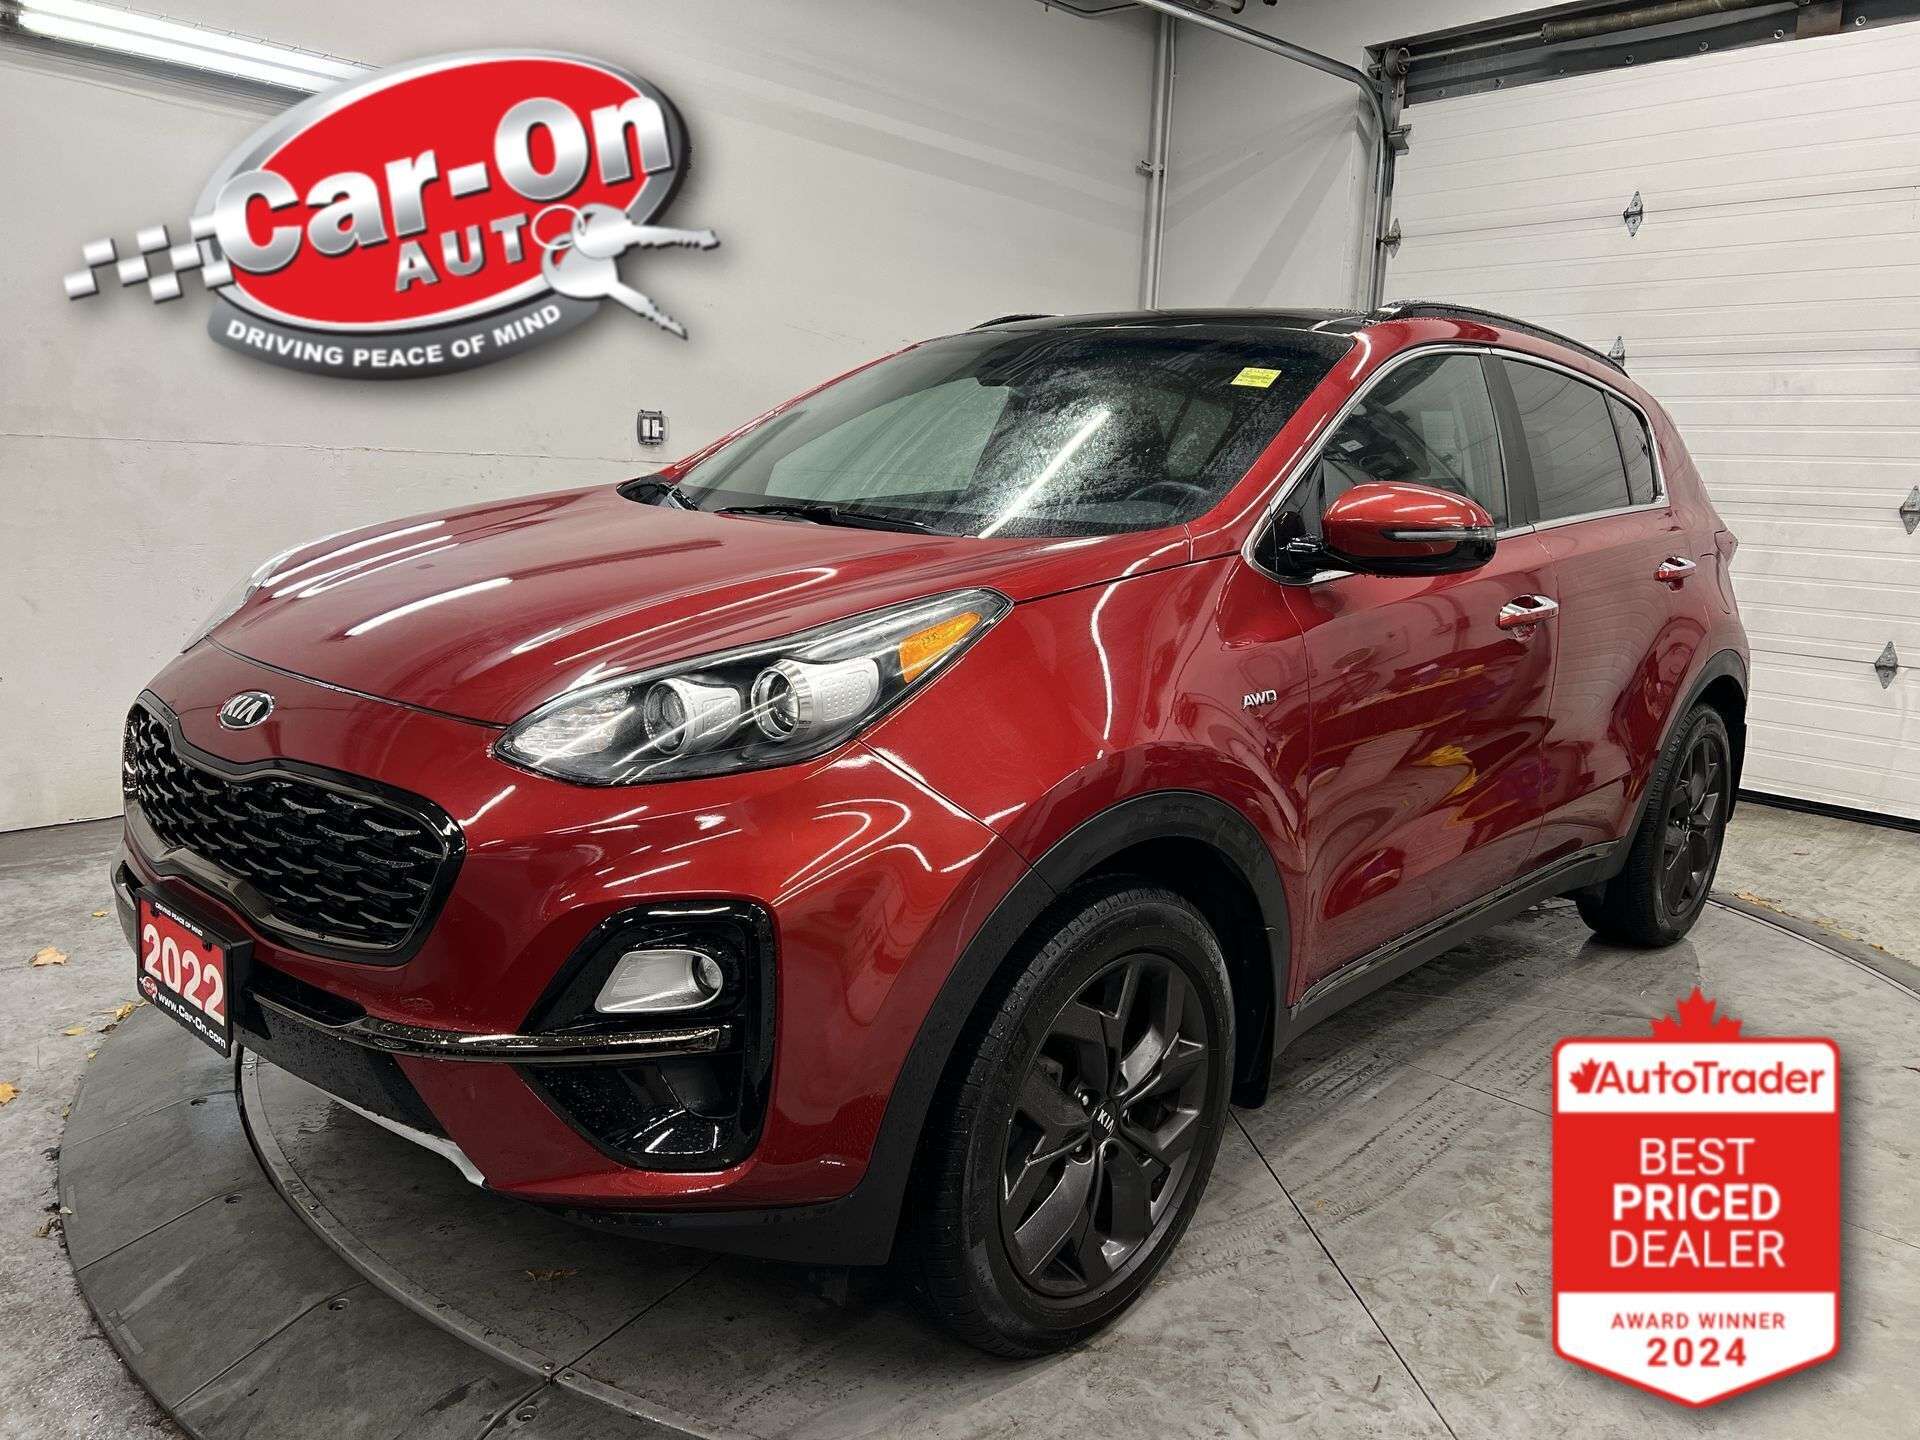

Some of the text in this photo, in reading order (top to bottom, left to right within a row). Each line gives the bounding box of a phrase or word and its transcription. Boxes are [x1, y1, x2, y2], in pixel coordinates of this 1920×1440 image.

[223, 695, 264, 724] KIA
[1243, 689, 1278, 707] AWD
[143, 923, 225, 1027] 2022
[157, 991, 227, 1050] www.Car-On.com
[1096, 1108, 1115, 1133] KIA
